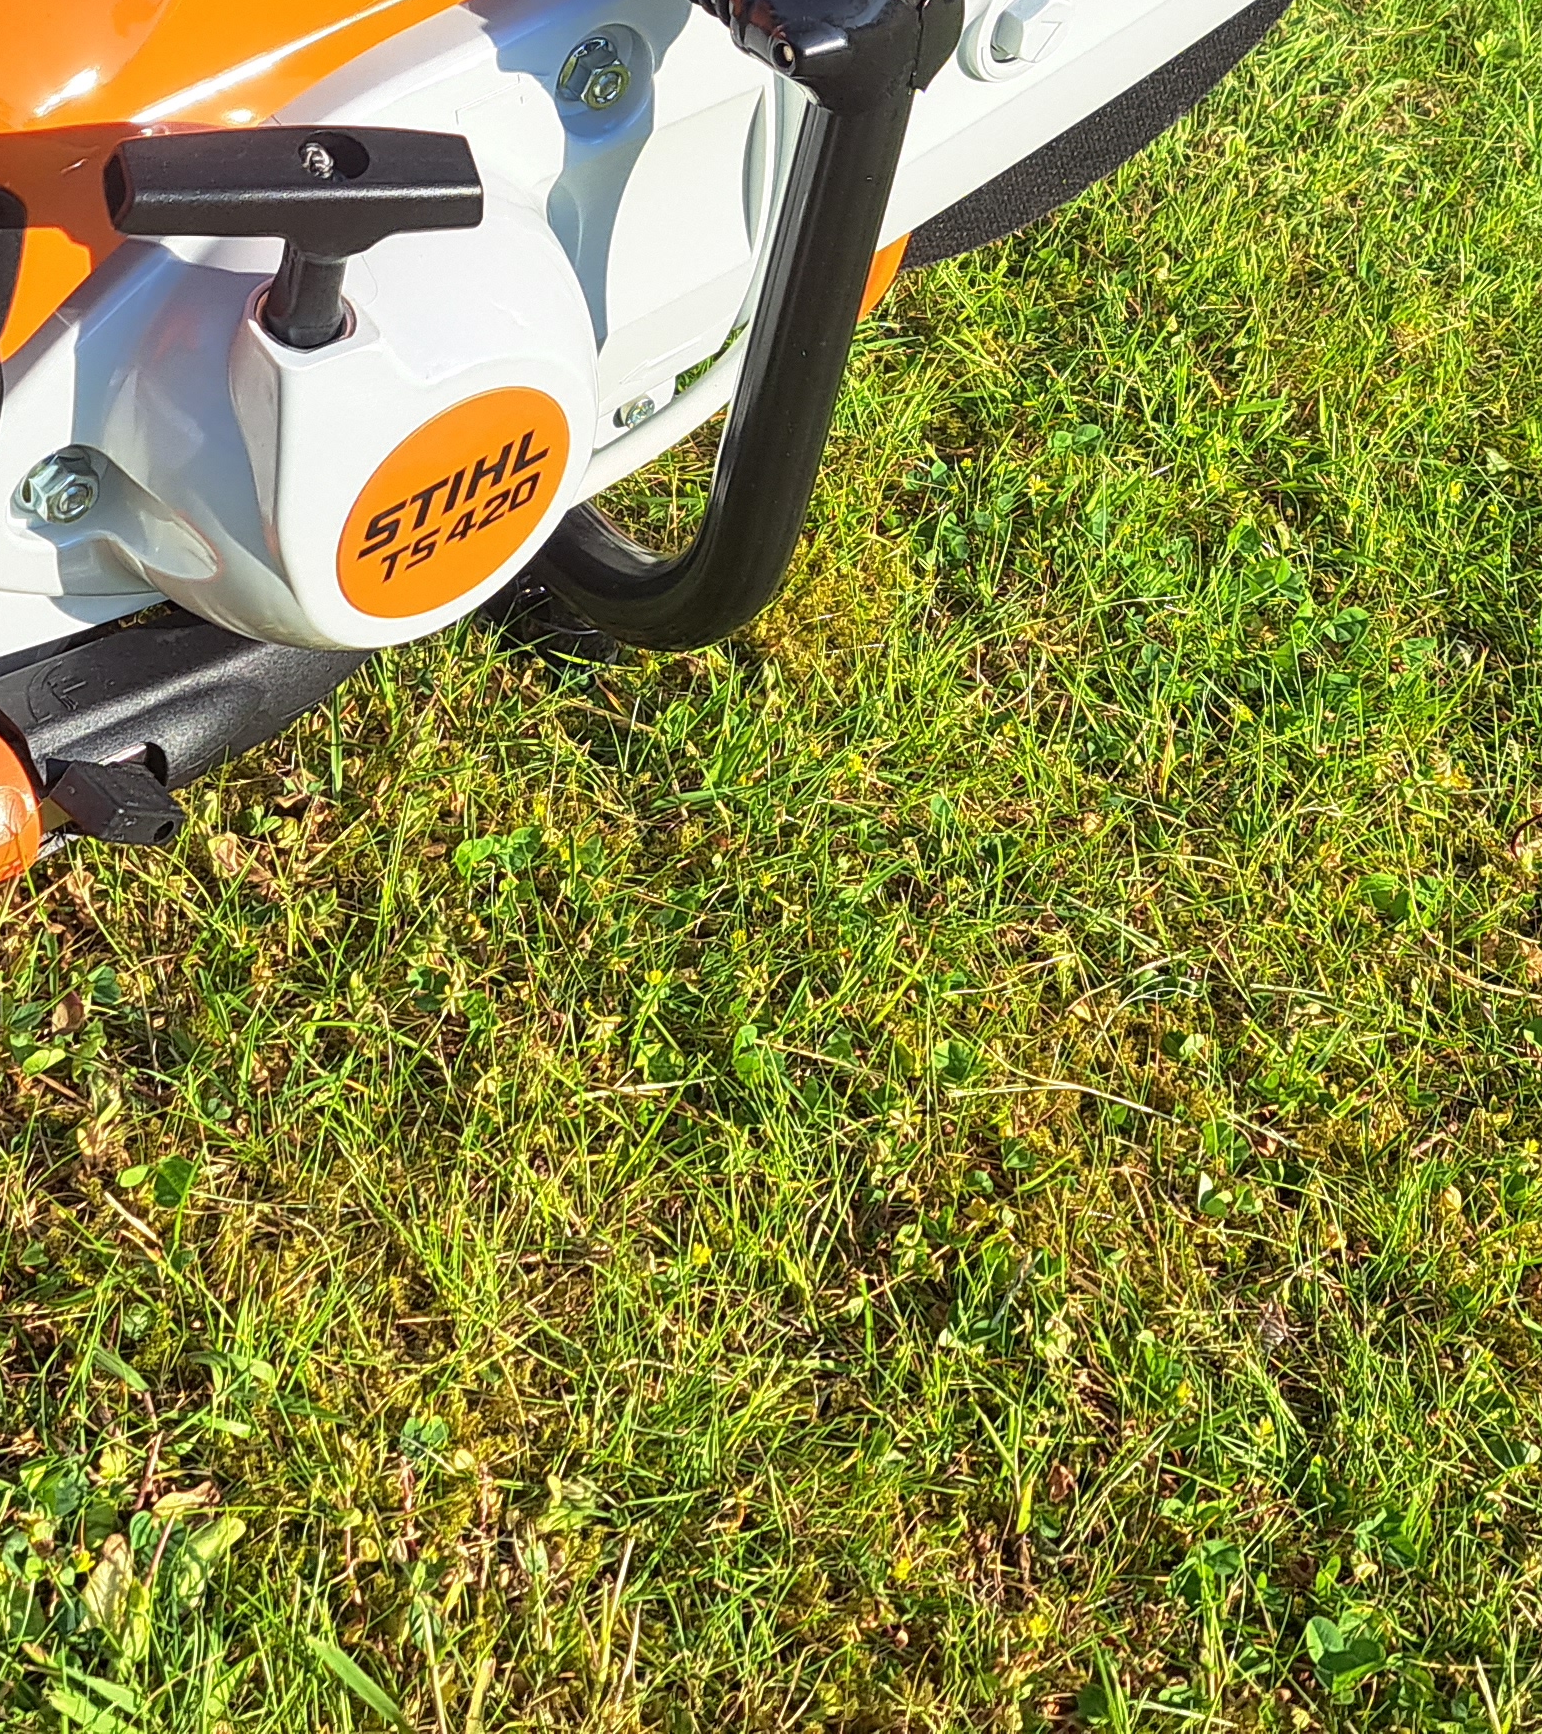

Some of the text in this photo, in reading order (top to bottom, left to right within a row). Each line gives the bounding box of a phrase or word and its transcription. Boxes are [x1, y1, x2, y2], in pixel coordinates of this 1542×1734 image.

[356, 428, 551, 561] STIHL
[380, 471, 542, 584] TS 420
